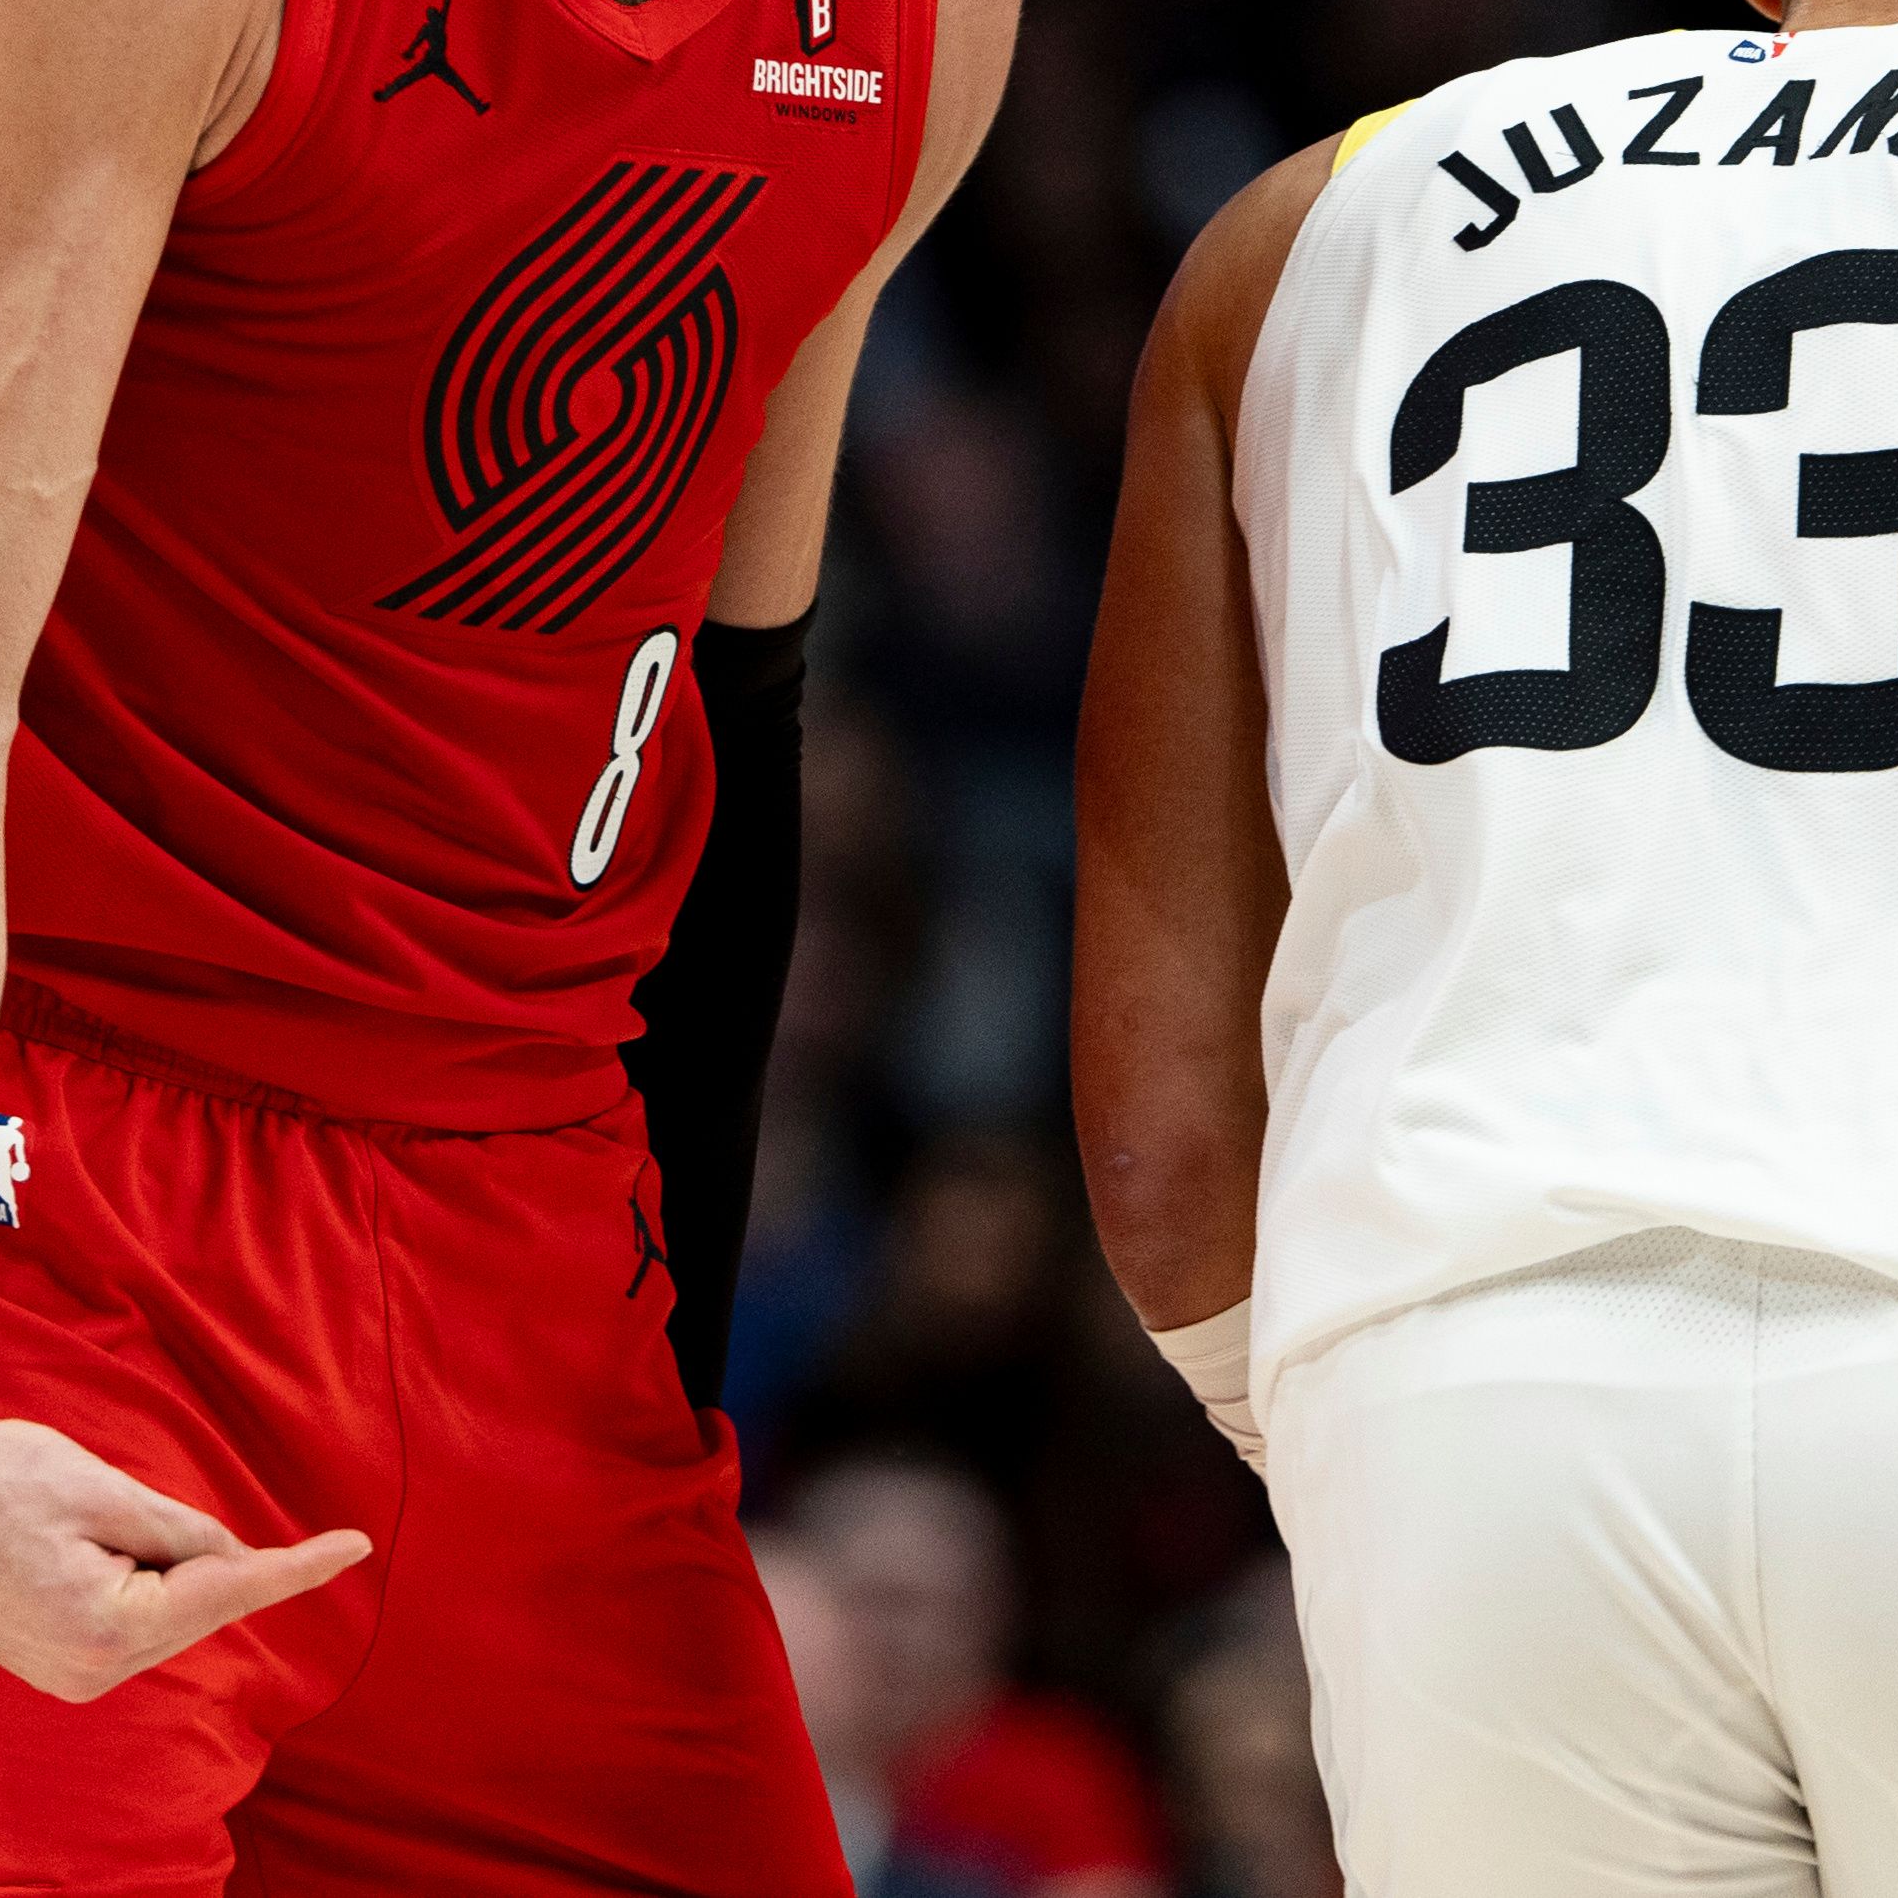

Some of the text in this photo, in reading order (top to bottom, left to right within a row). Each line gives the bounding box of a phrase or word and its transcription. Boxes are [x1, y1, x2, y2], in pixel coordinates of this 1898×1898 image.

[753, 59, 883, 104] BRIGHTSIDE
[776, 104, 858, 125] WINDOWS
[570, 624, 680, 893] 8
